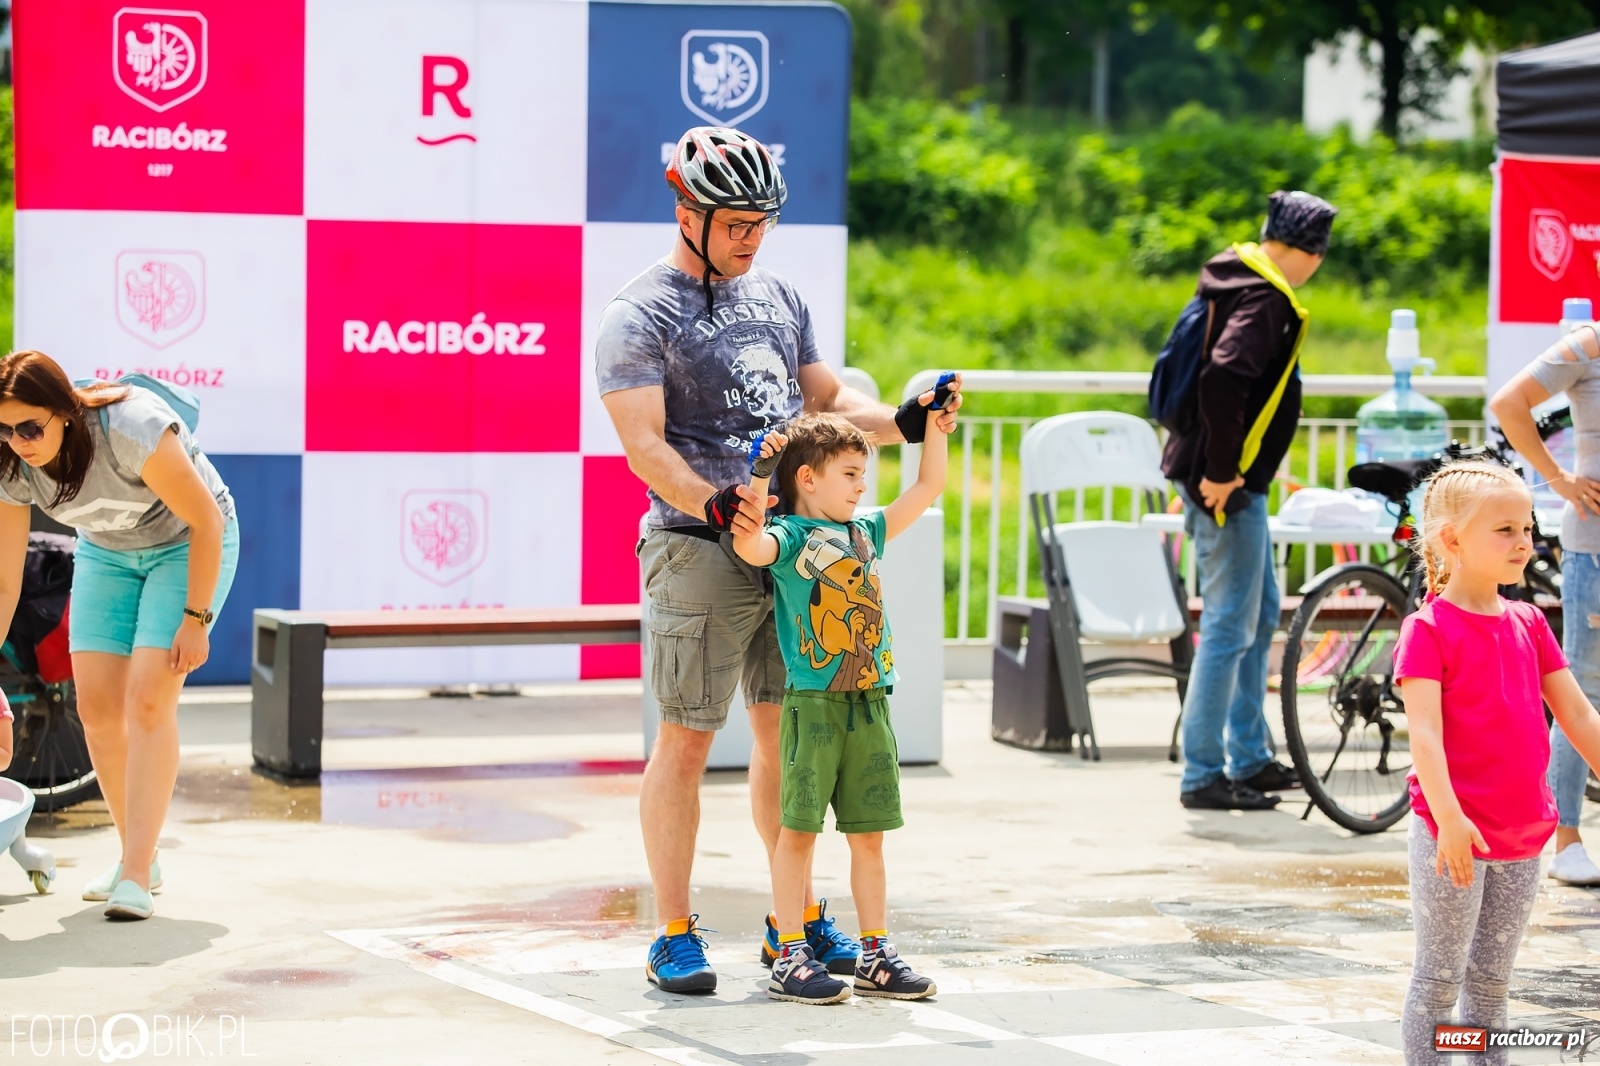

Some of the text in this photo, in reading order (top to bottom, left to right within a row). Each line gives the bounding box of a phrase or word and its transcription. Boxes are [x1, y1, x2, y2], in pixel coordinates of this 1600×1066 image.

[421, 55, 471, 118] R
[92, 122, 227, 152] RACIBÓRZ
[343, 312, 545, 355] RACIBÓRZ
[793, 965, 815, 981] N
[874, 969, 891, 986] N
